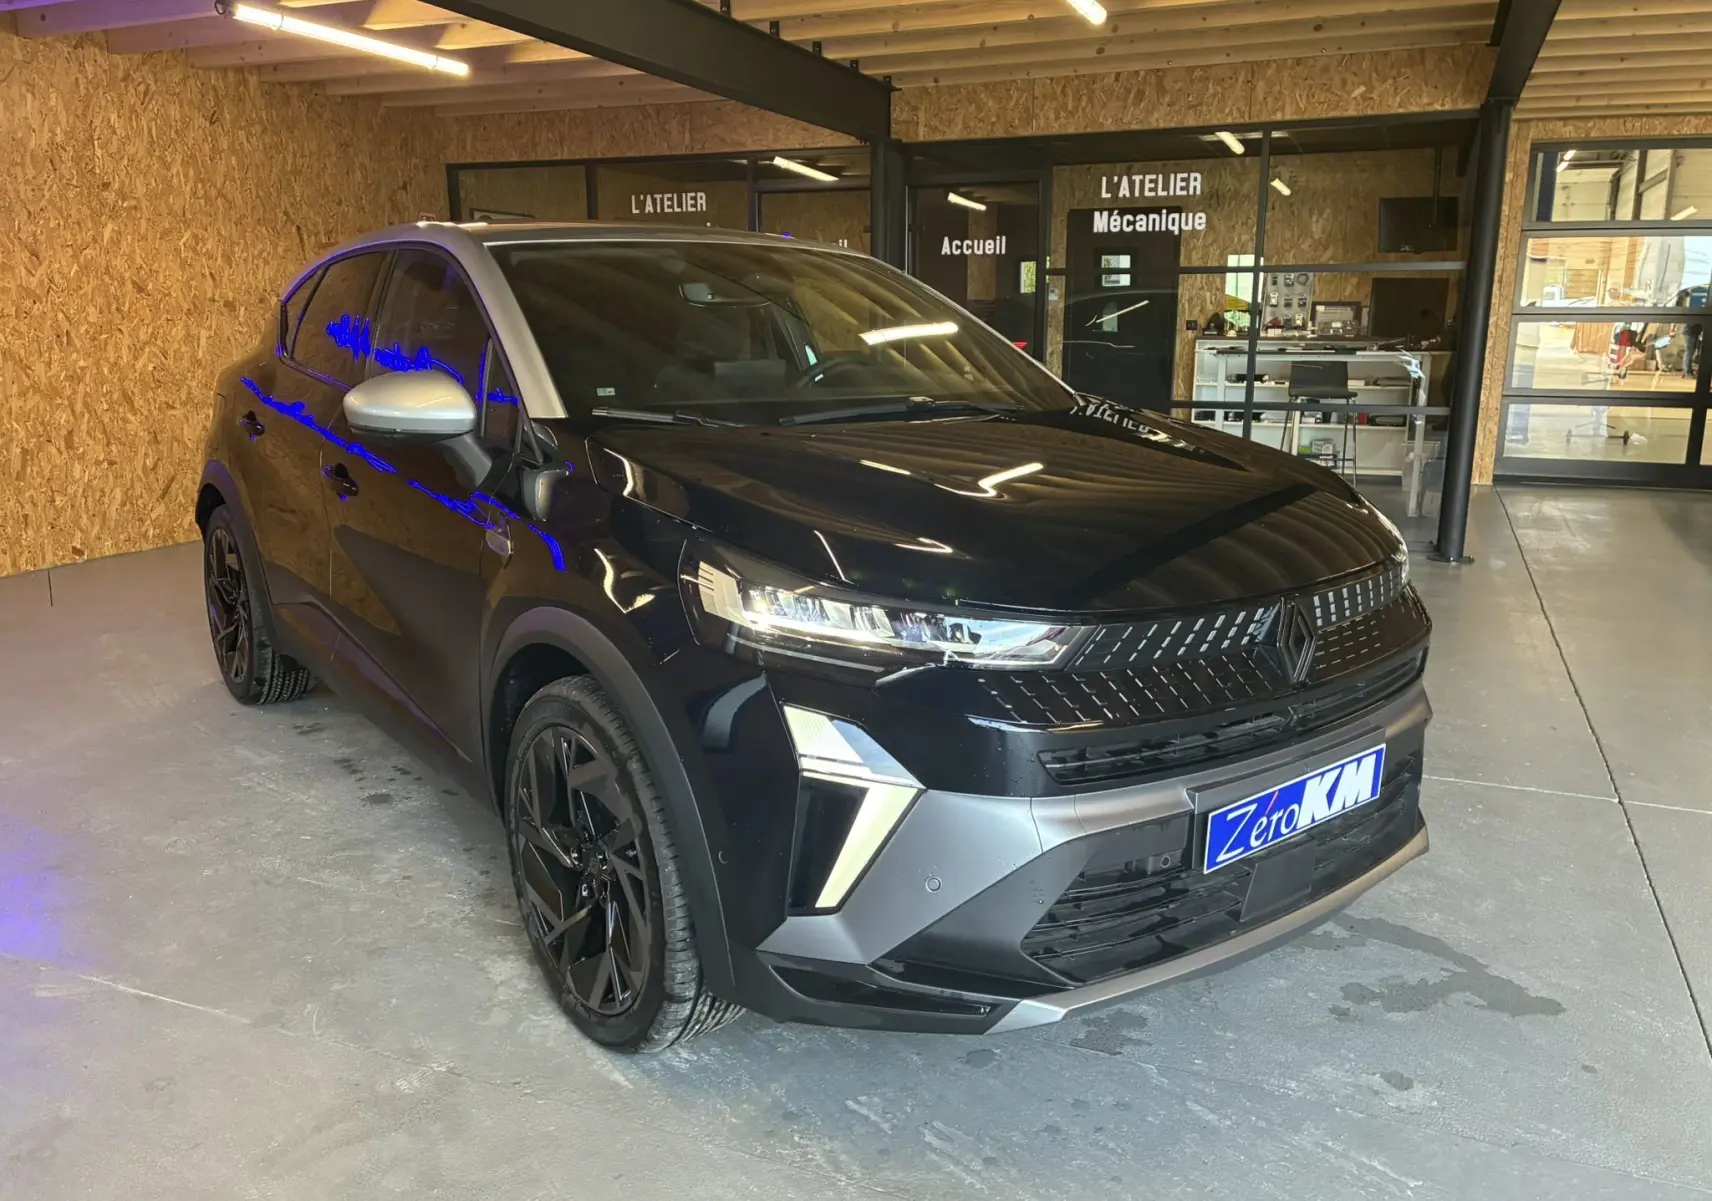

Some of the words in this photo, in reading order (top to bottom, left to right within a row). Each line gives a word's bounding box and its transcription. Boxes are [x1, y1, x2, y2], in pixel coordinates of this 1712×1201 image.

[1101, 172, 1202, 198] L'ATELIER
[631, 192, 707, 214] L'ATELIER
[1093, 209, 1207, 235] Mécanique
[941, 235, 1006, 255] Accueil
